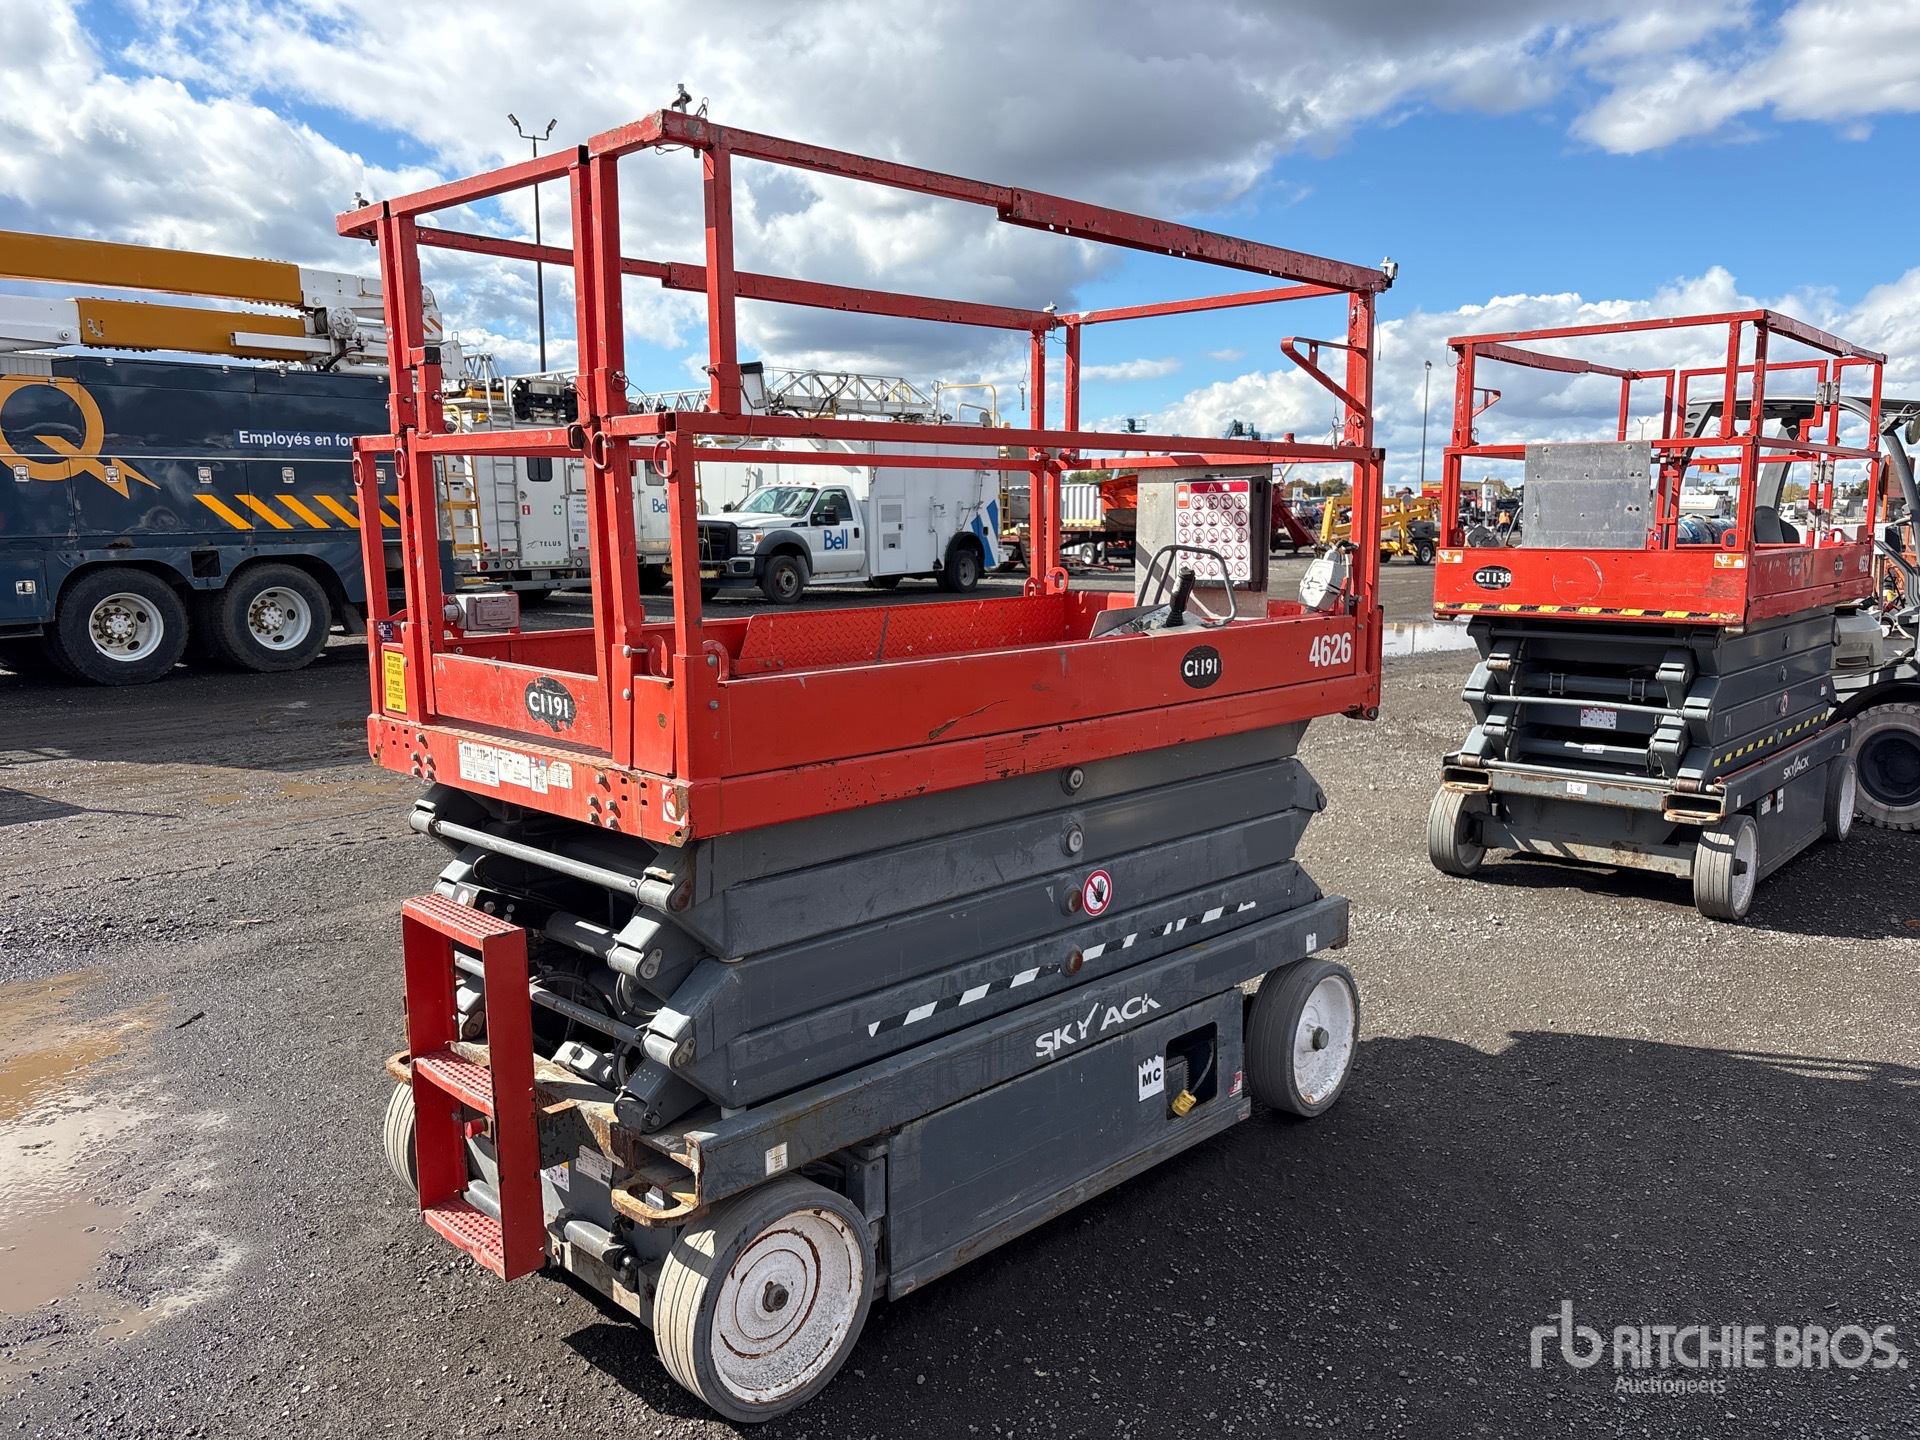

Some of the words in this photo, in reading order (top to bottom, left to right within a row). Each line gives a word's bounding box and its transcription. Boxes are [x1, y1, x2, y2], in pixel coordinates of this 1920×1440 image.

[239, 430, 311, 448] Employés
[314, 435, 332, 446] en
[335, 434, 353, 447] for
[652, 498, 668, 513] Bel
[824, 529, 848, 550] Bell
[1309, 632, 1352, 668] 4626
[1142, 1067, 1161, 1087] MC
